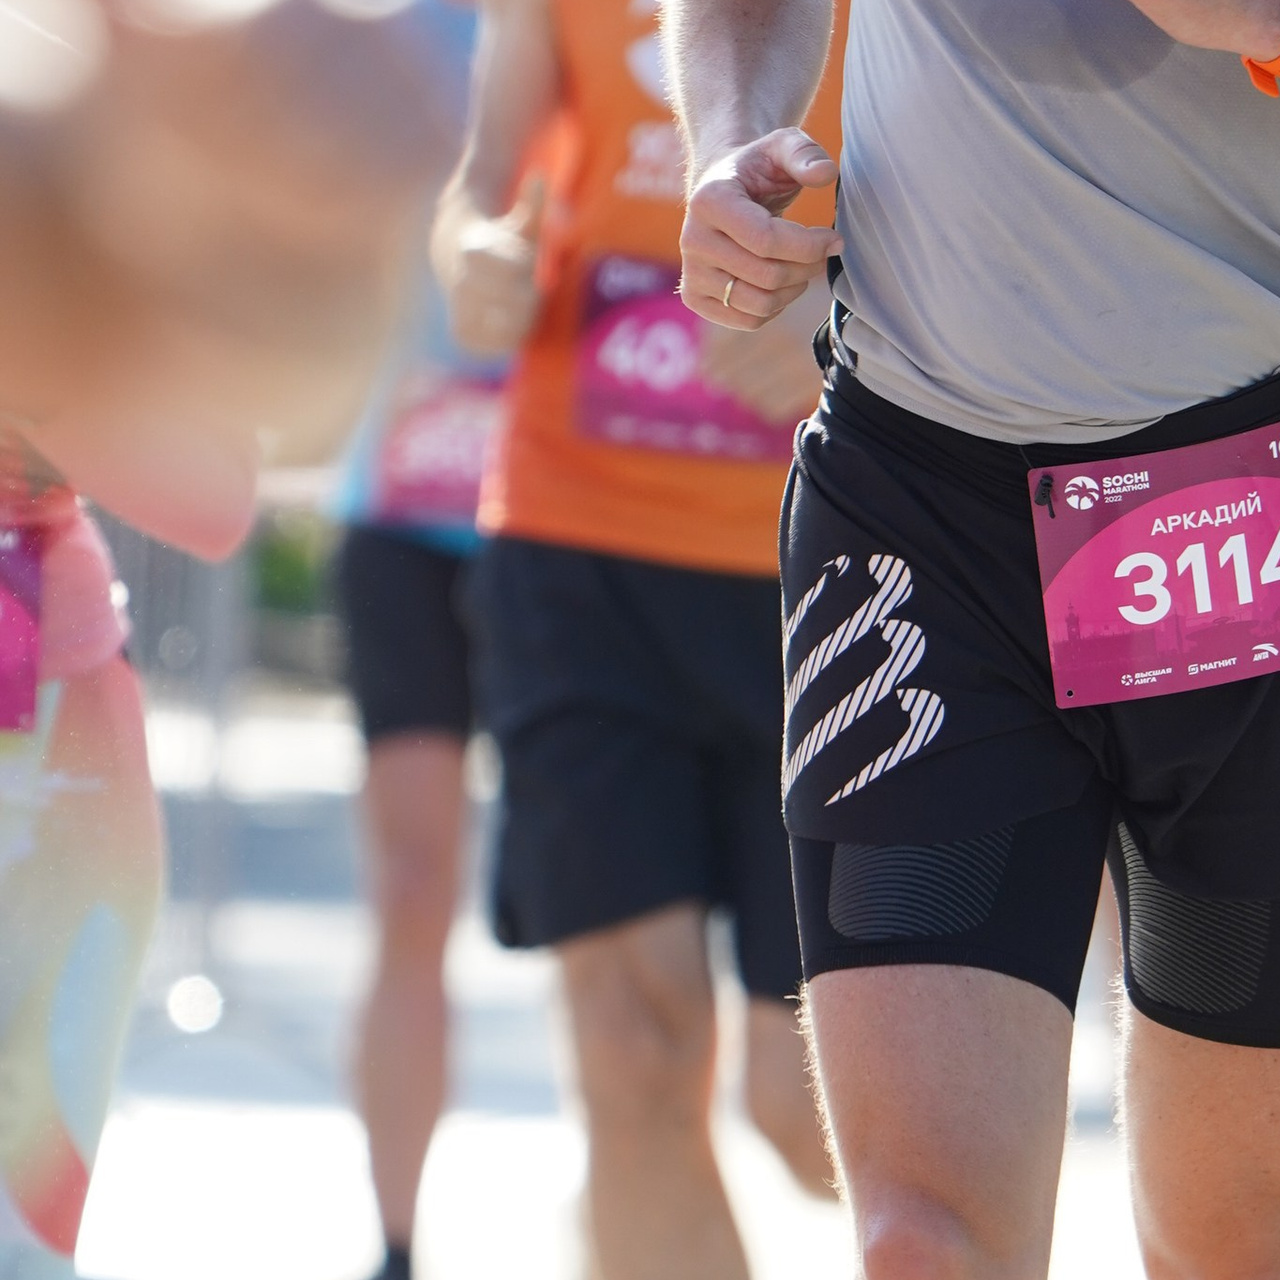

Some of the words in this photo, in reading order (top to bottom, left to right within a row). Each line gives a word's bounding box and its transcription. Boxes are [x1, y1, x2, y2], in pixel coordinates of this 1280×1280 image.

[1102, 470, 1150, 488] SOCHI
[1103, 482, 1150, 496] MARATHON
[1104, 494, 1123, 504] 2022
[1150, 491, 1263, 536] АРКАДИЙ
[1199, 657, 1237, 672] МАГНИТ
[1134, 667, 1173, 679] ВЫСШАЯ
[1134, 676, 1158, 686] ЛИГА
